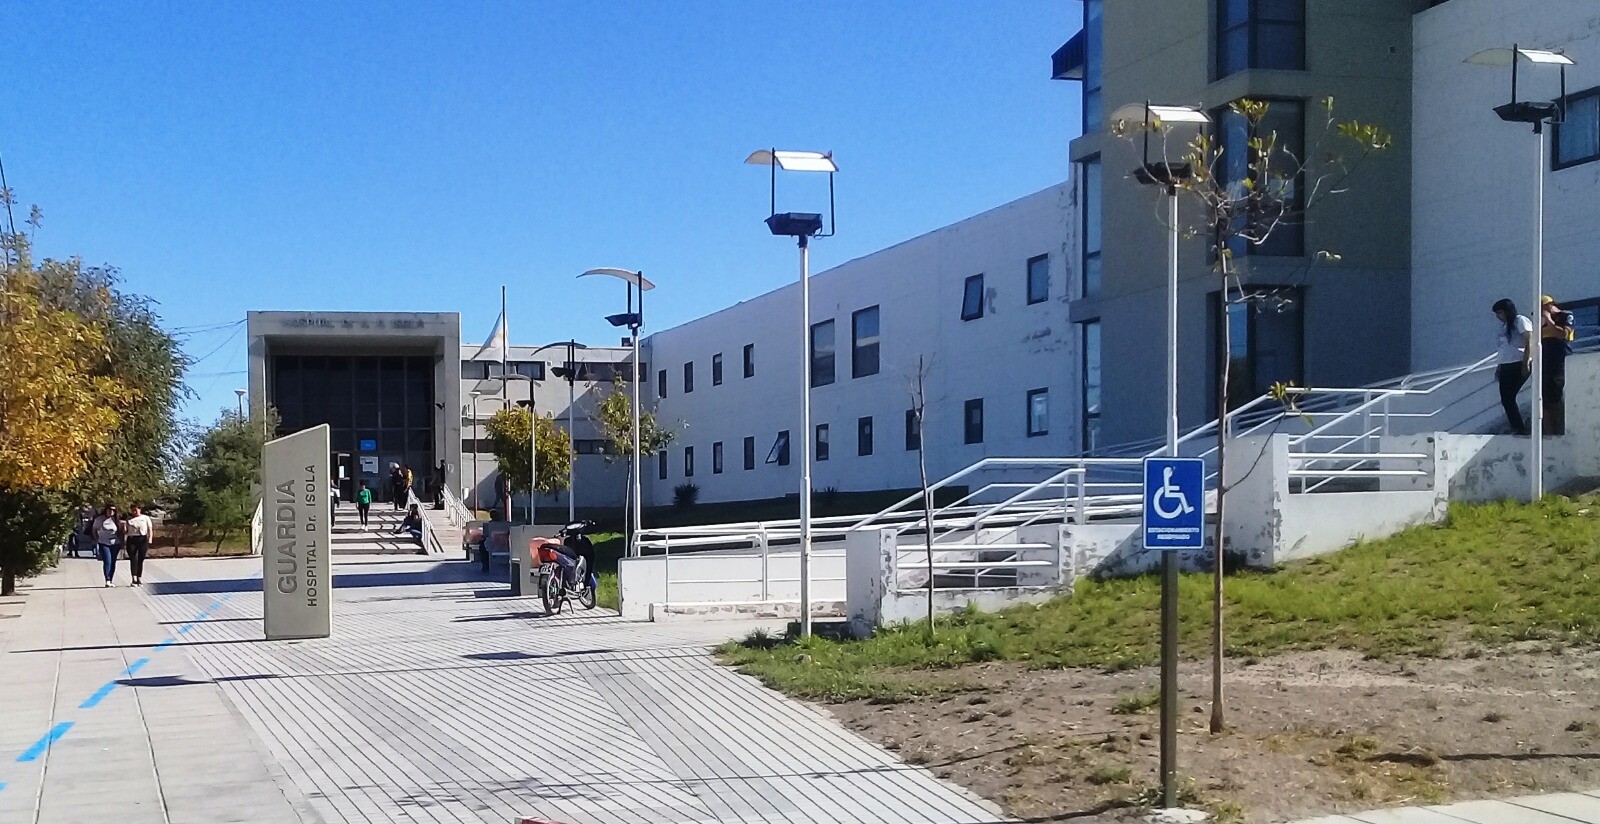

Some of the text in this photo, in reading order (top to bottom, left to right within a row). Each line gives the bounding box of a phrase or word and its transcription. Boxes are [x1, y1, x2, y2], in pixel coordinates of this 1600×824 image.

[276, 479, 298, 594] GUARDIA
[305, 464, 318, 607] HOSPITAL Dr. ISOLA
